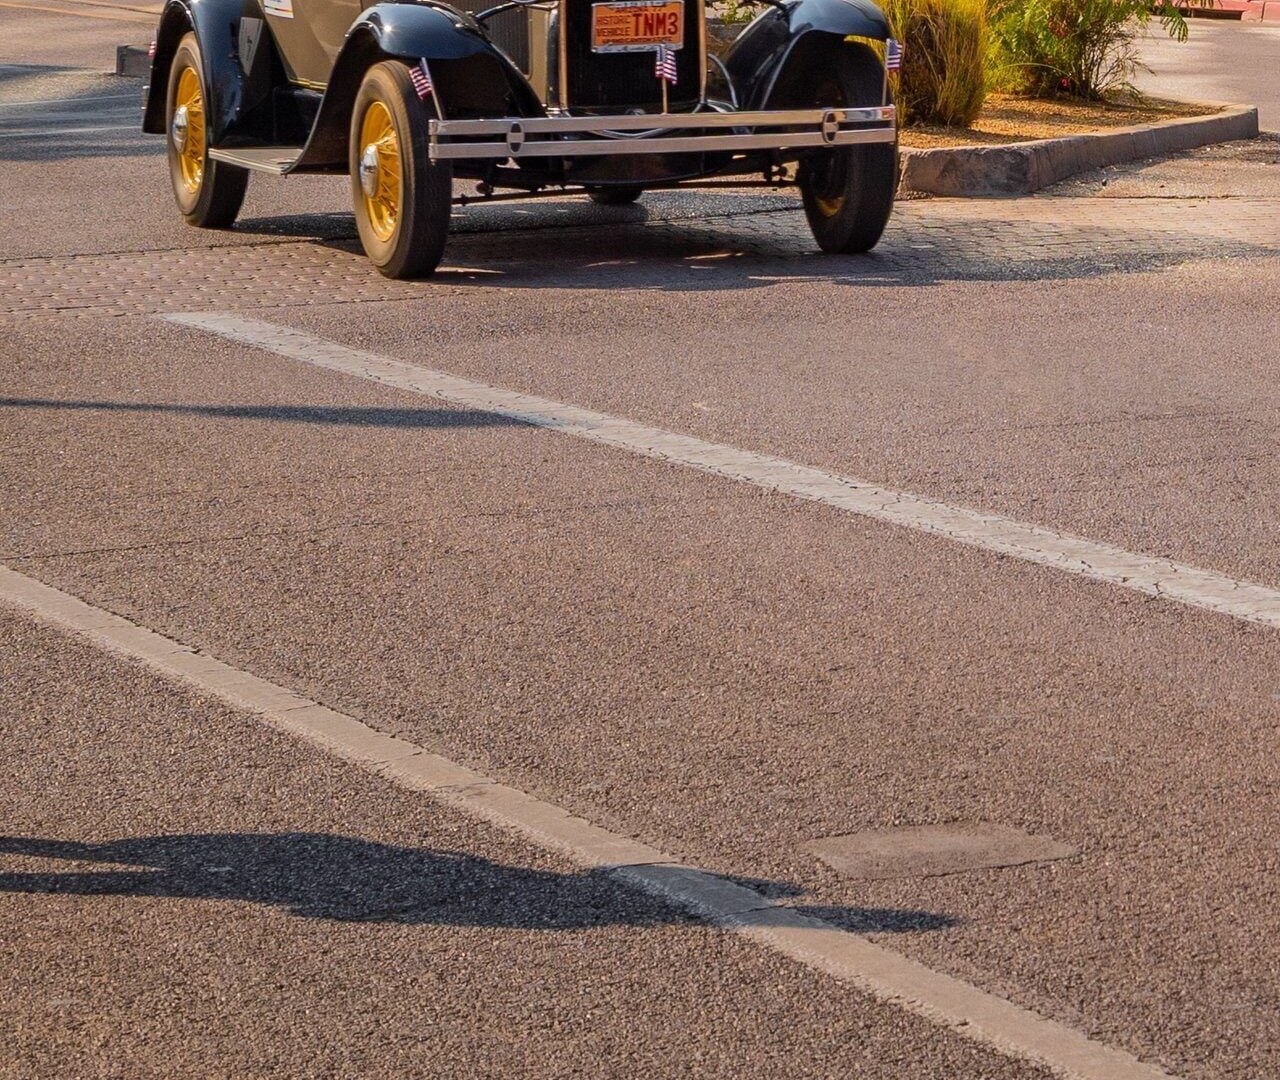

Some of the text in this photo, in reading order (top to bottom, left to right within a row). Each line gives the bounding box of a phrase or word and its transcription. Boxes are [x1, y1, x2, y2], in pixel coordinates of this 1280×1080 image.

[596, 14, 631, 25] HISTORIC
[632, 12, 679, 36] TNM3
[596, 26, 631, 37] VEHICLE
